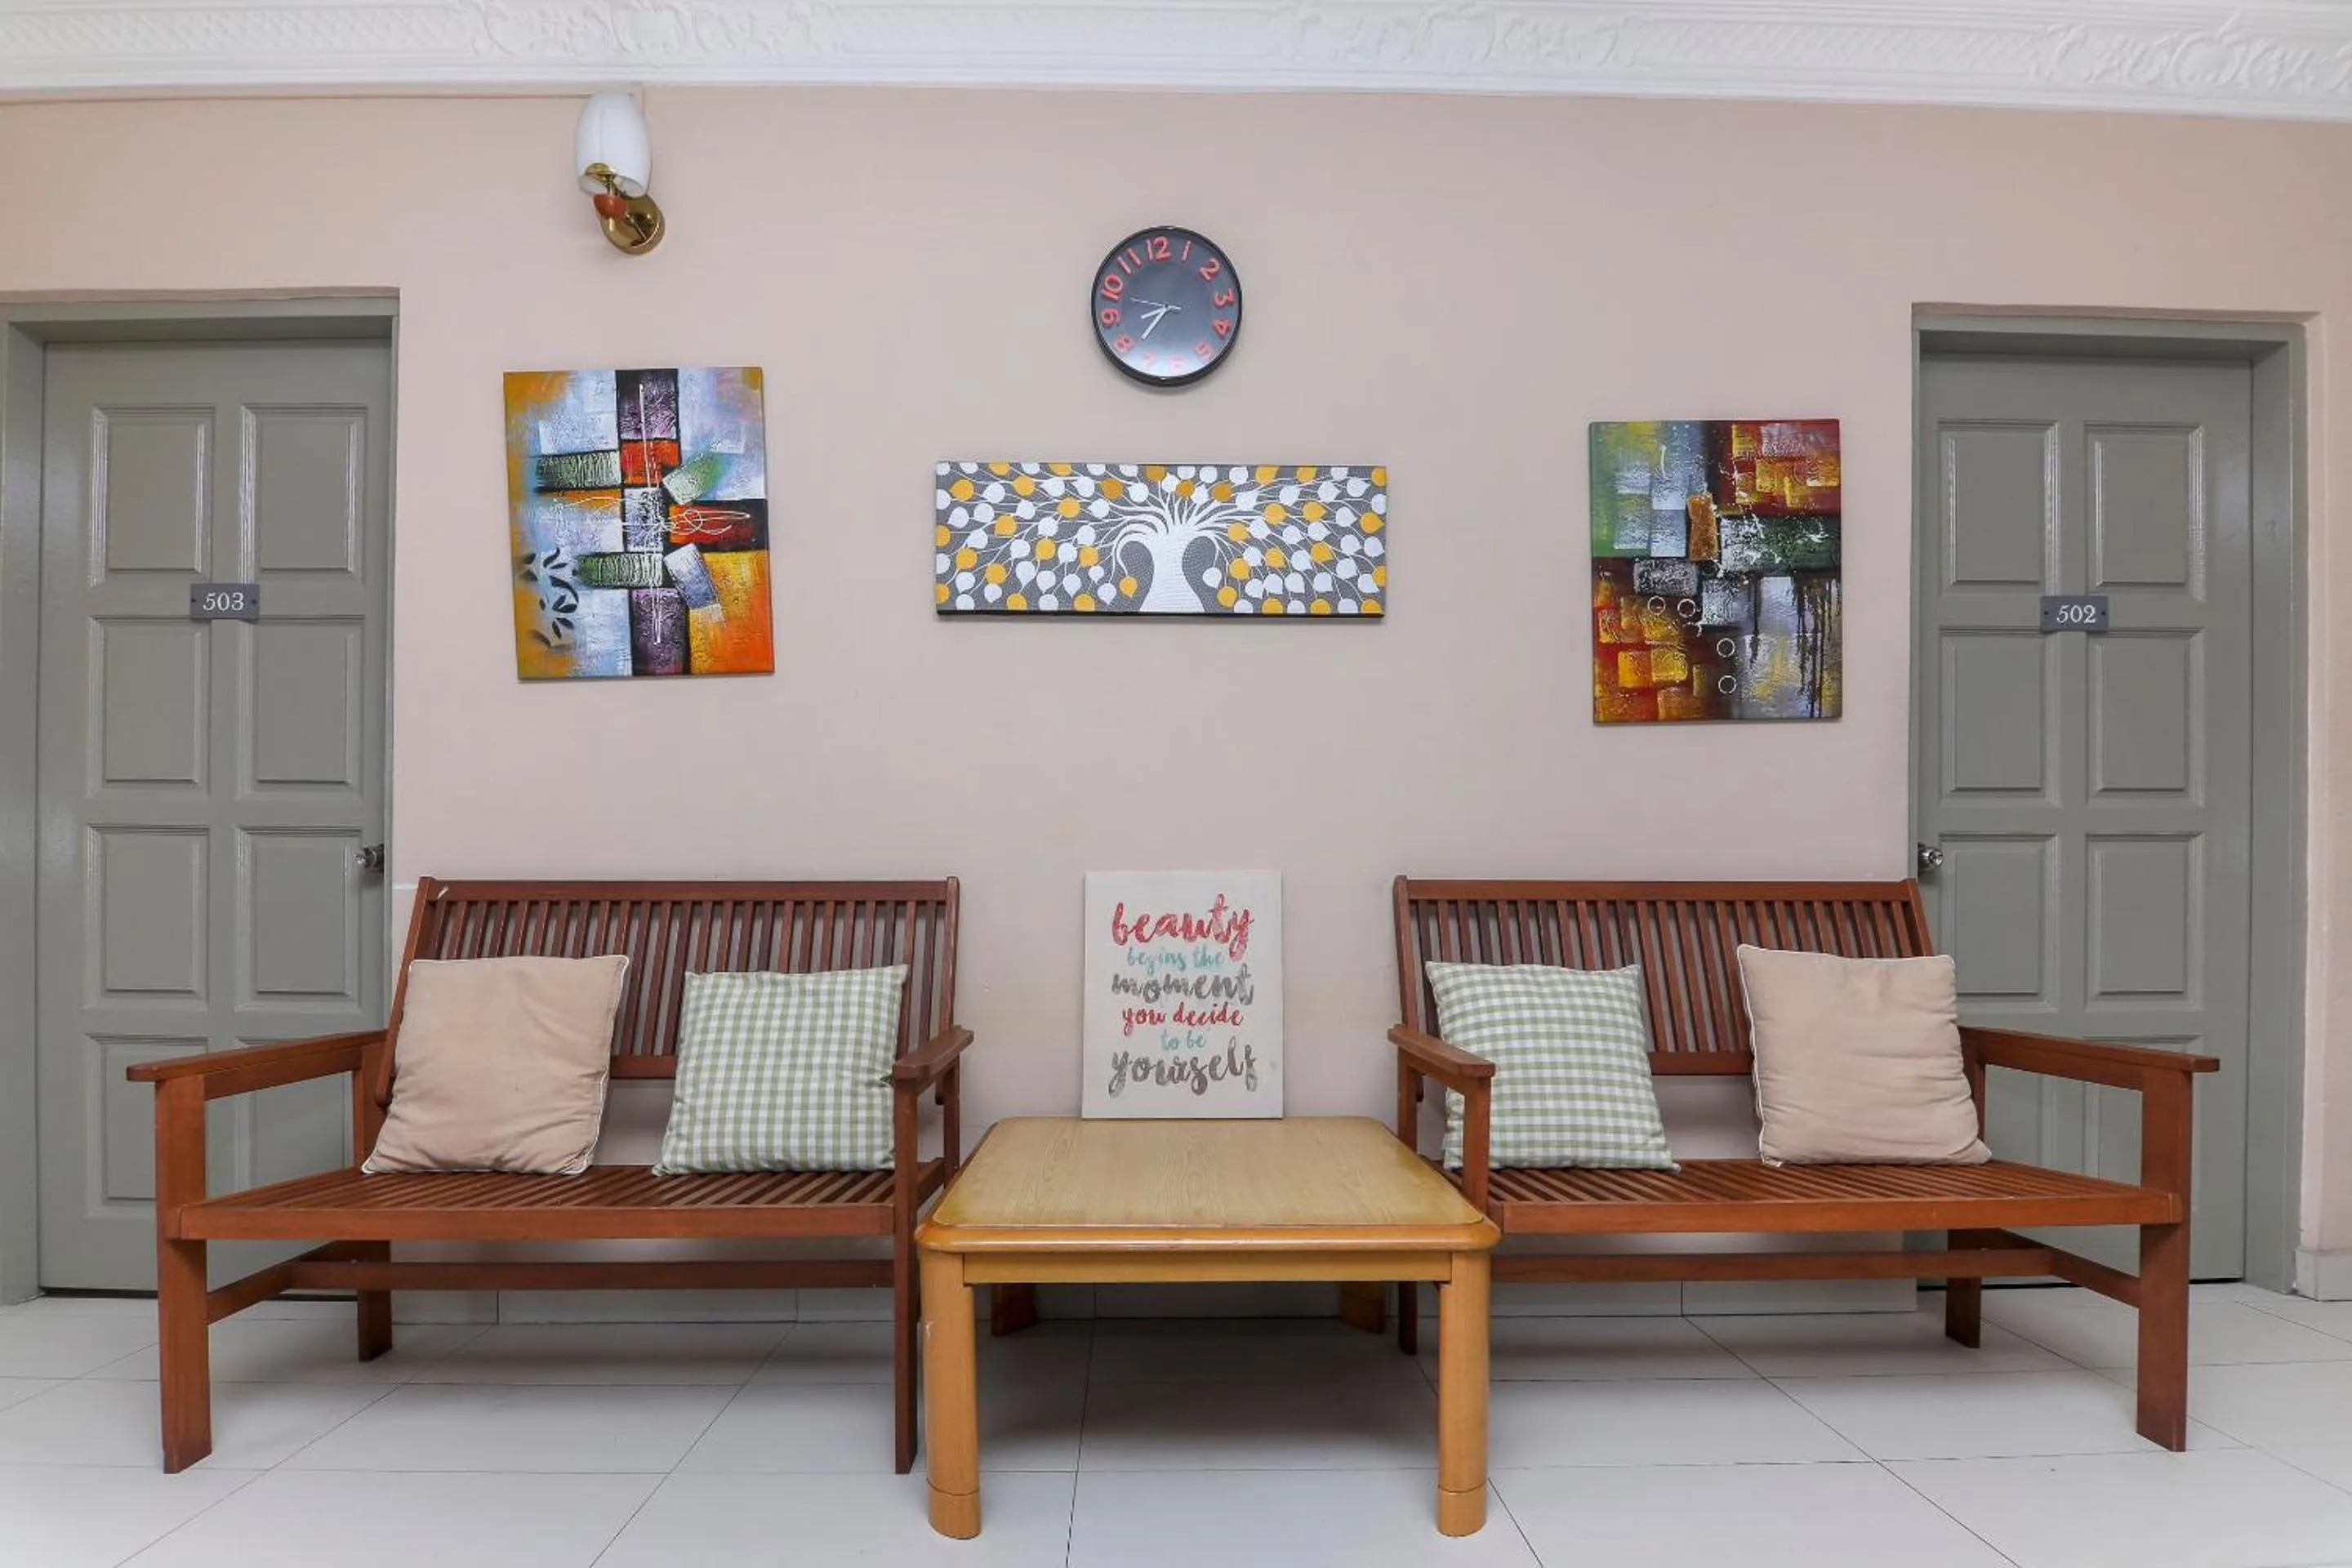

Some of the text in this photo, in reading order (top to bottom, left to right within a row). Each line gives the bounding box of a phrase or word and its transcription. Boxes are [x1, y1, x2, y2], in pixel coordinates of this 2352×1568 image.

[1147, 236, 1171, 261] 12
[1182, 240, 1192, 261] 1
[1117, 247, 1142, 274] 11
[1199, 257, 1221, 281] 2
[1102, 274, 1124, 301] 10
[1214, 288, 1235, 306] 3
[1101, 308, 1120, 325] 9
[1212, 319, 1231, 336] 4
[1113, 335, 1133, 352] 8
[1195, 341, 1214, 359] 5
[203, 592, 244, 611] 503
[2056, 604, 2096, 624] 502
[1111, 893, 1255, 962] beauty
[1126, 943, 1223, 976] begins the
[1111, 963, 1254, 1006] moment
[1122, 1001, 1245, 1037] you decide
[1160, 1029, 1208, 1051] to be
[1107, 1035, 1258, 1098] yourself
